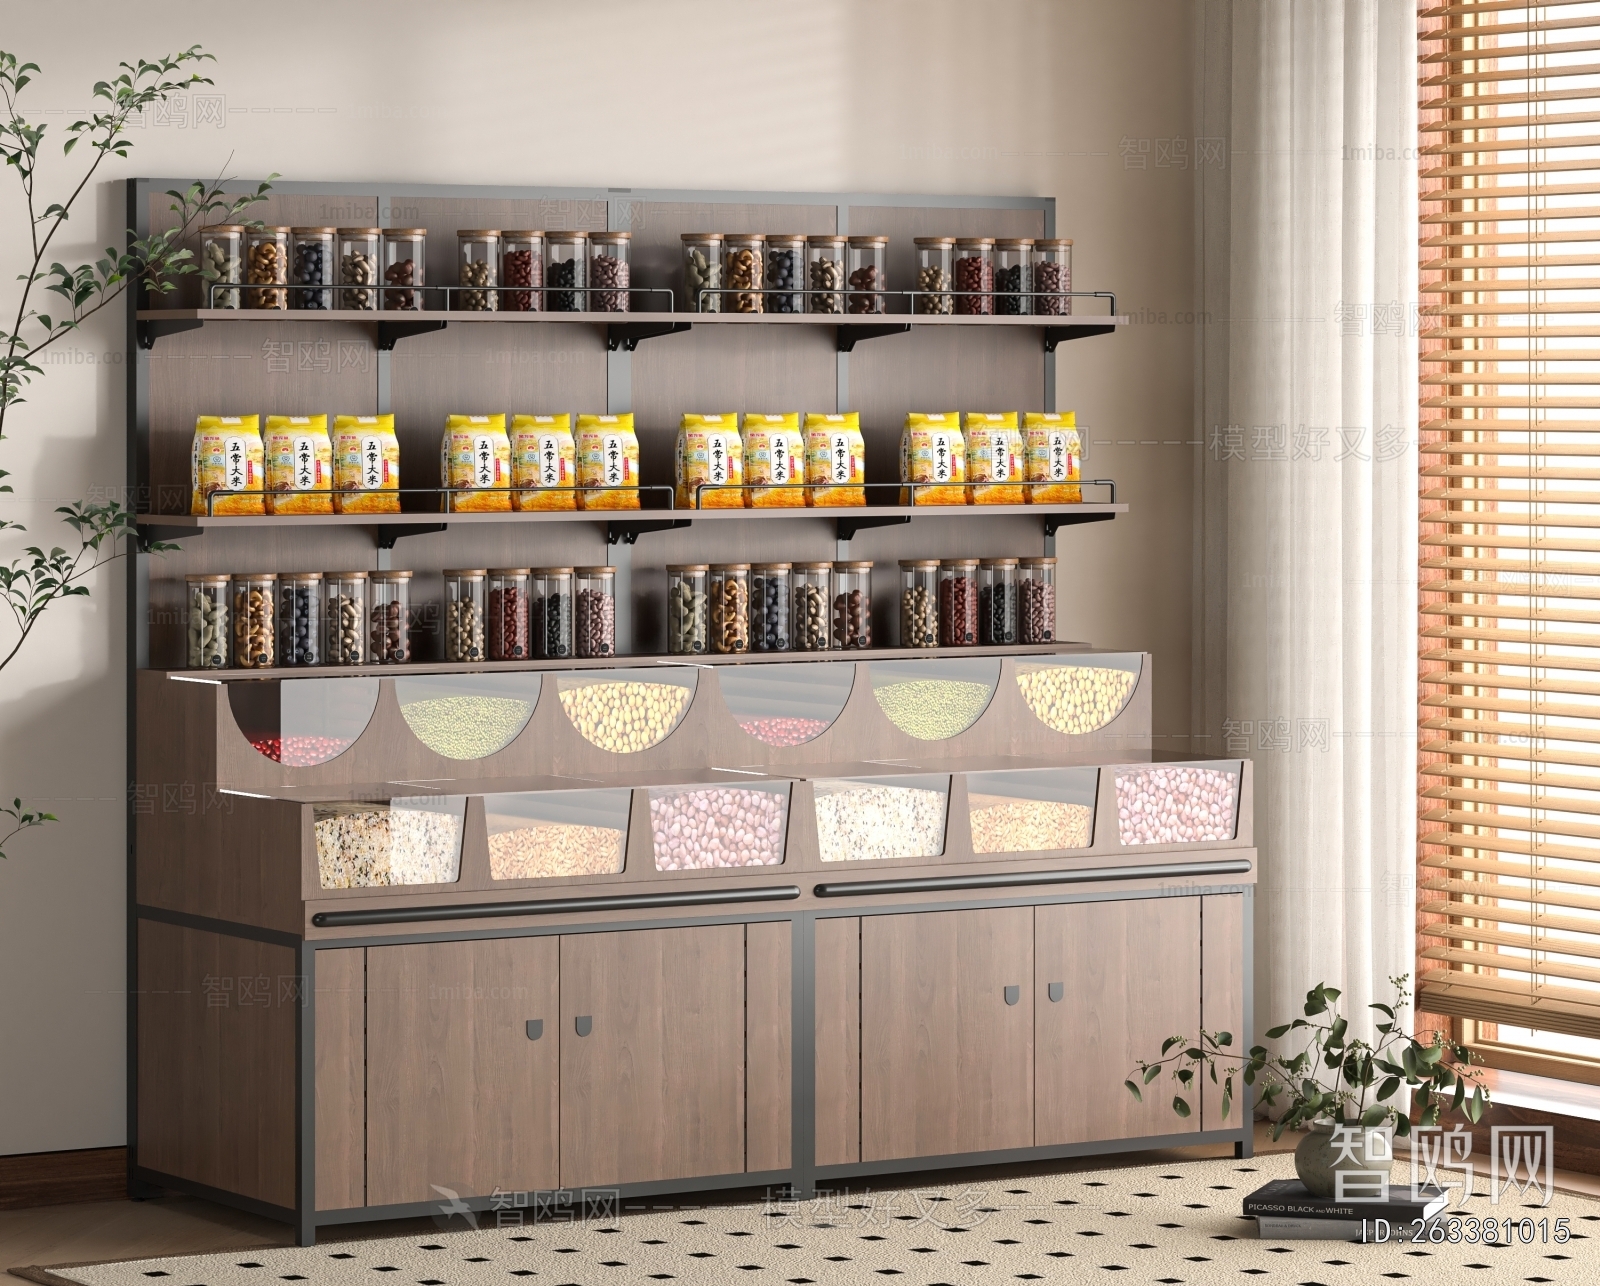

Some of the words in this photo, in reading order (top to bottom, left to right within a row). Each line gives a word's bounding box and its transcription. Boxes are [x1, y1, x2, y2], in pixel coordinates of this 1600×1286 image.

[230, 443, 244, 487] 五常大米
[299, 442, 311, 485] 五常大米
[367, 442, 380, 485] 五常大米
[479, 441, 490, 483] 五常大米
[544, 441, 557, 483] 五常大米
[608, 440, 621, 482] 五常大米
[713, 440, 724, 481] 五常大米
[775, 439, 785, 480] 五常大米
[836, 439, 846, 479] 五常大米
[937, 438, 947, 478] 五常大米
[996, 438, 1006, 477] 五常大米
[1054, 437, 1065, 478] 五常大米
[1248, 1203, 1285, 1212] PICASSO
[1287, 1205, 1314, 1213] BLACK
[1325, 1207, 1353, 1215] WHITE
